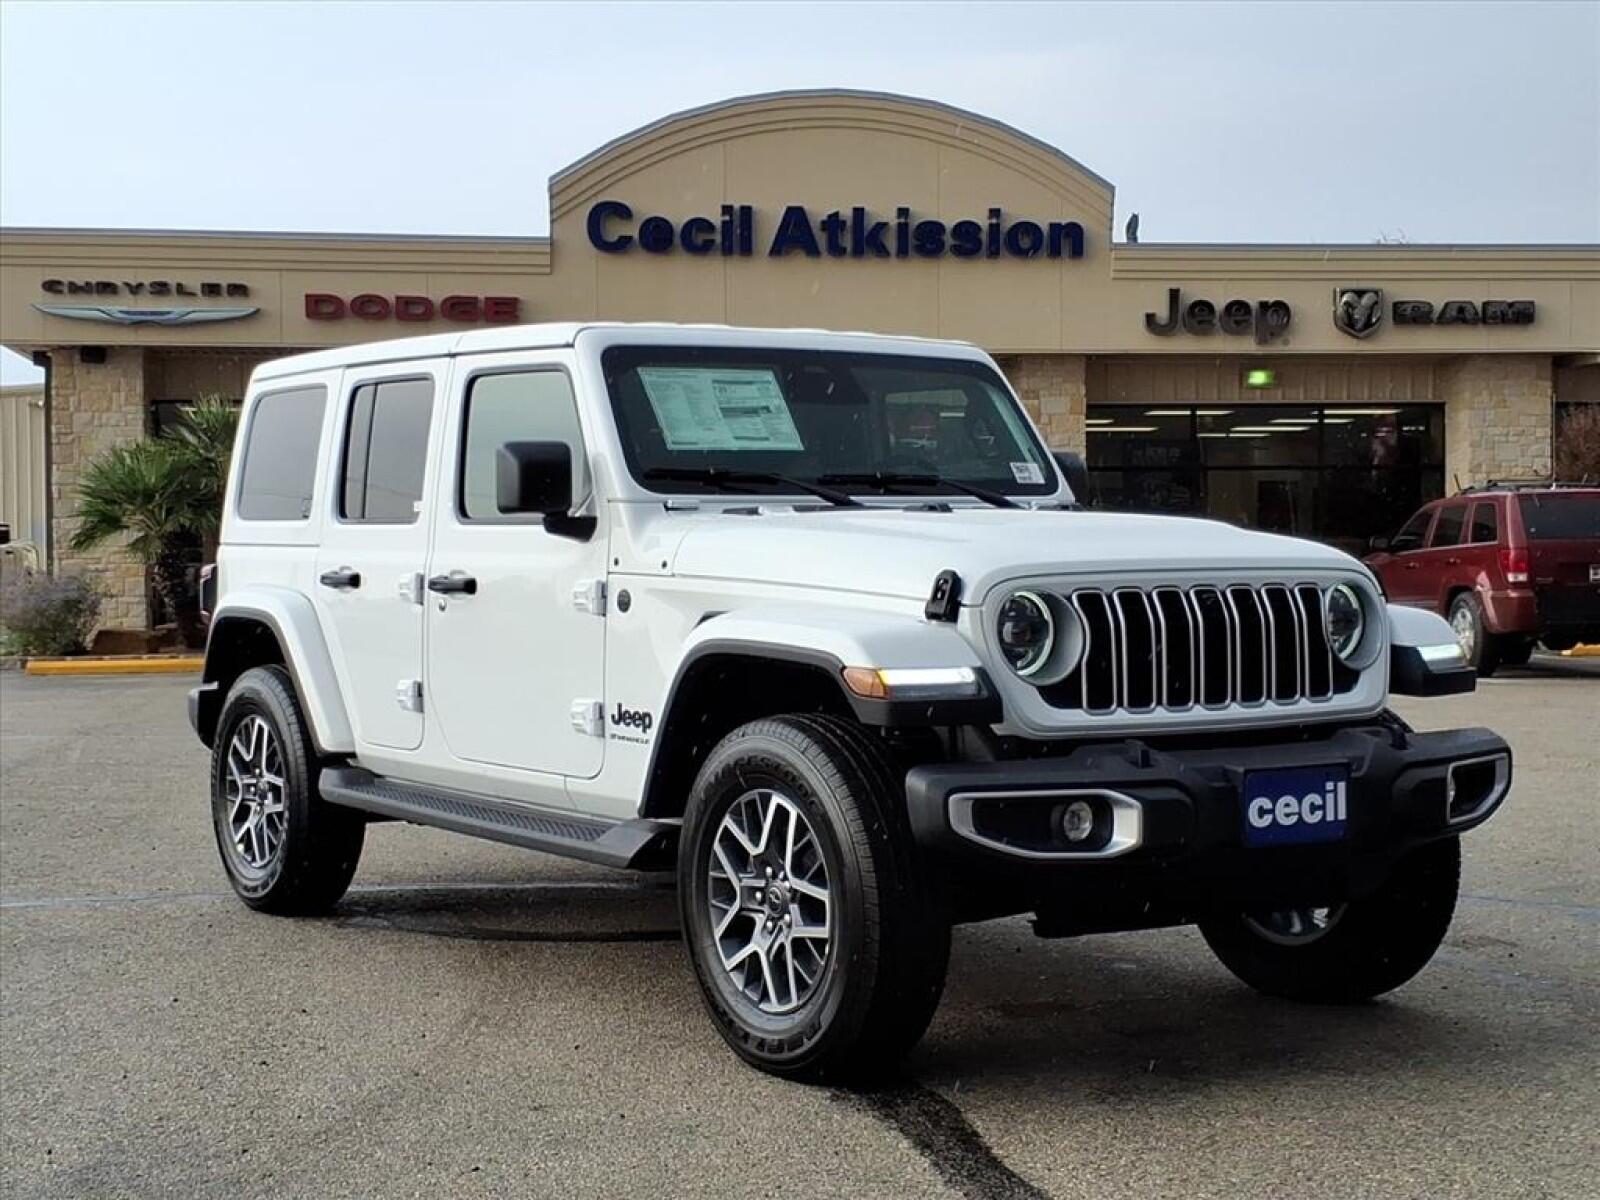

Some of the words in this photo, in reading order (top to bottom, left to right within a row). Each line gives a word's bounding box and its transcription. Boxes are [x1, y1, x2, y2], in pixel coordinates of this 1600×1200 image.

[586, 200, 753, 256] Cecil
[768, 205, 1085, 259] Atkission
[41, 279, 249, 297] CHRYSLER
[304, 293, 521, 322] DODGE
[1145, 288, 1291, 345] Jeep
[1393, 300, 1536, 325] RAM
[611, 702, 653, 734] Jeep
[1248, 781, 1347, 828] cecil
